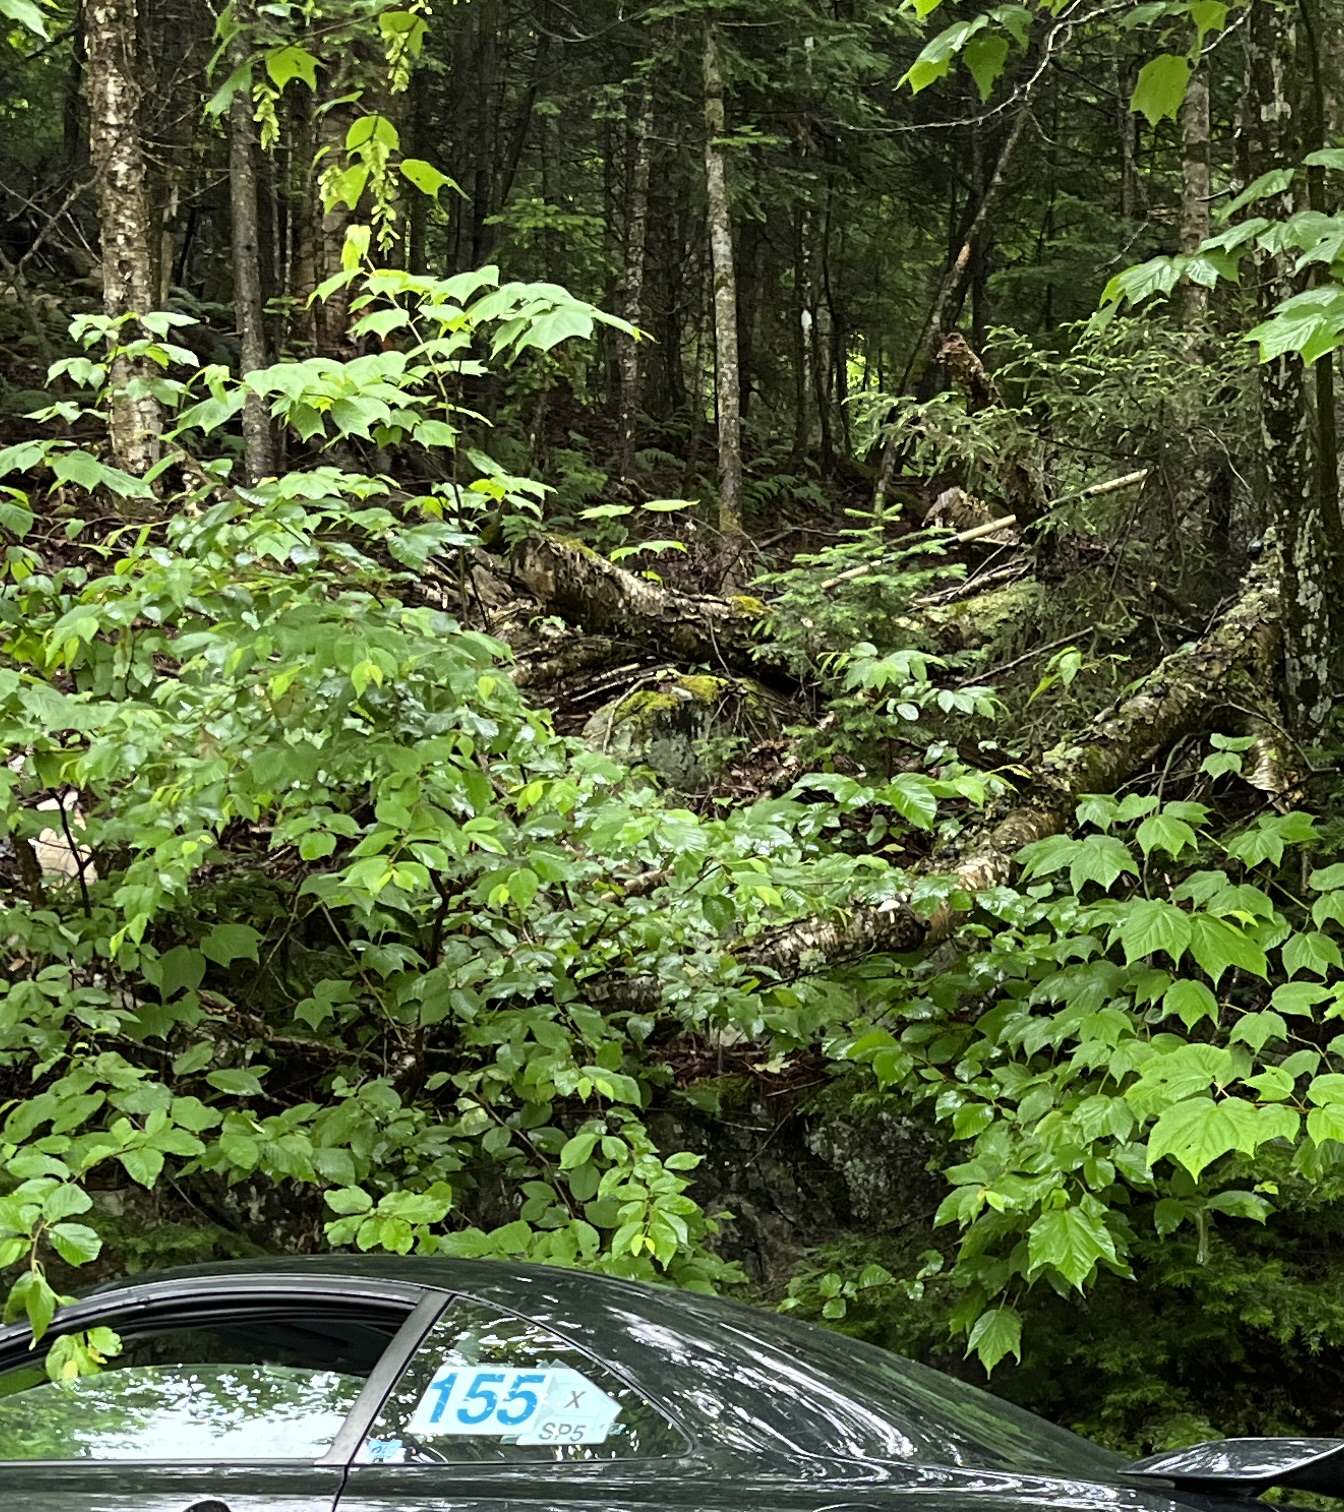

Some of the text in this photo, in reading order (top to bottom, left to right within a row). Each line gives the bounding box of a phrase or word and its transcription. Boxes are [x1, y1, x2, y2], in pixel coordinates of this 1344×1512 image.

[429, 1372, 546, 1426] 155
[564, 1390, 587, 1409] X
[538, 1422, 587, 1442] SP5
